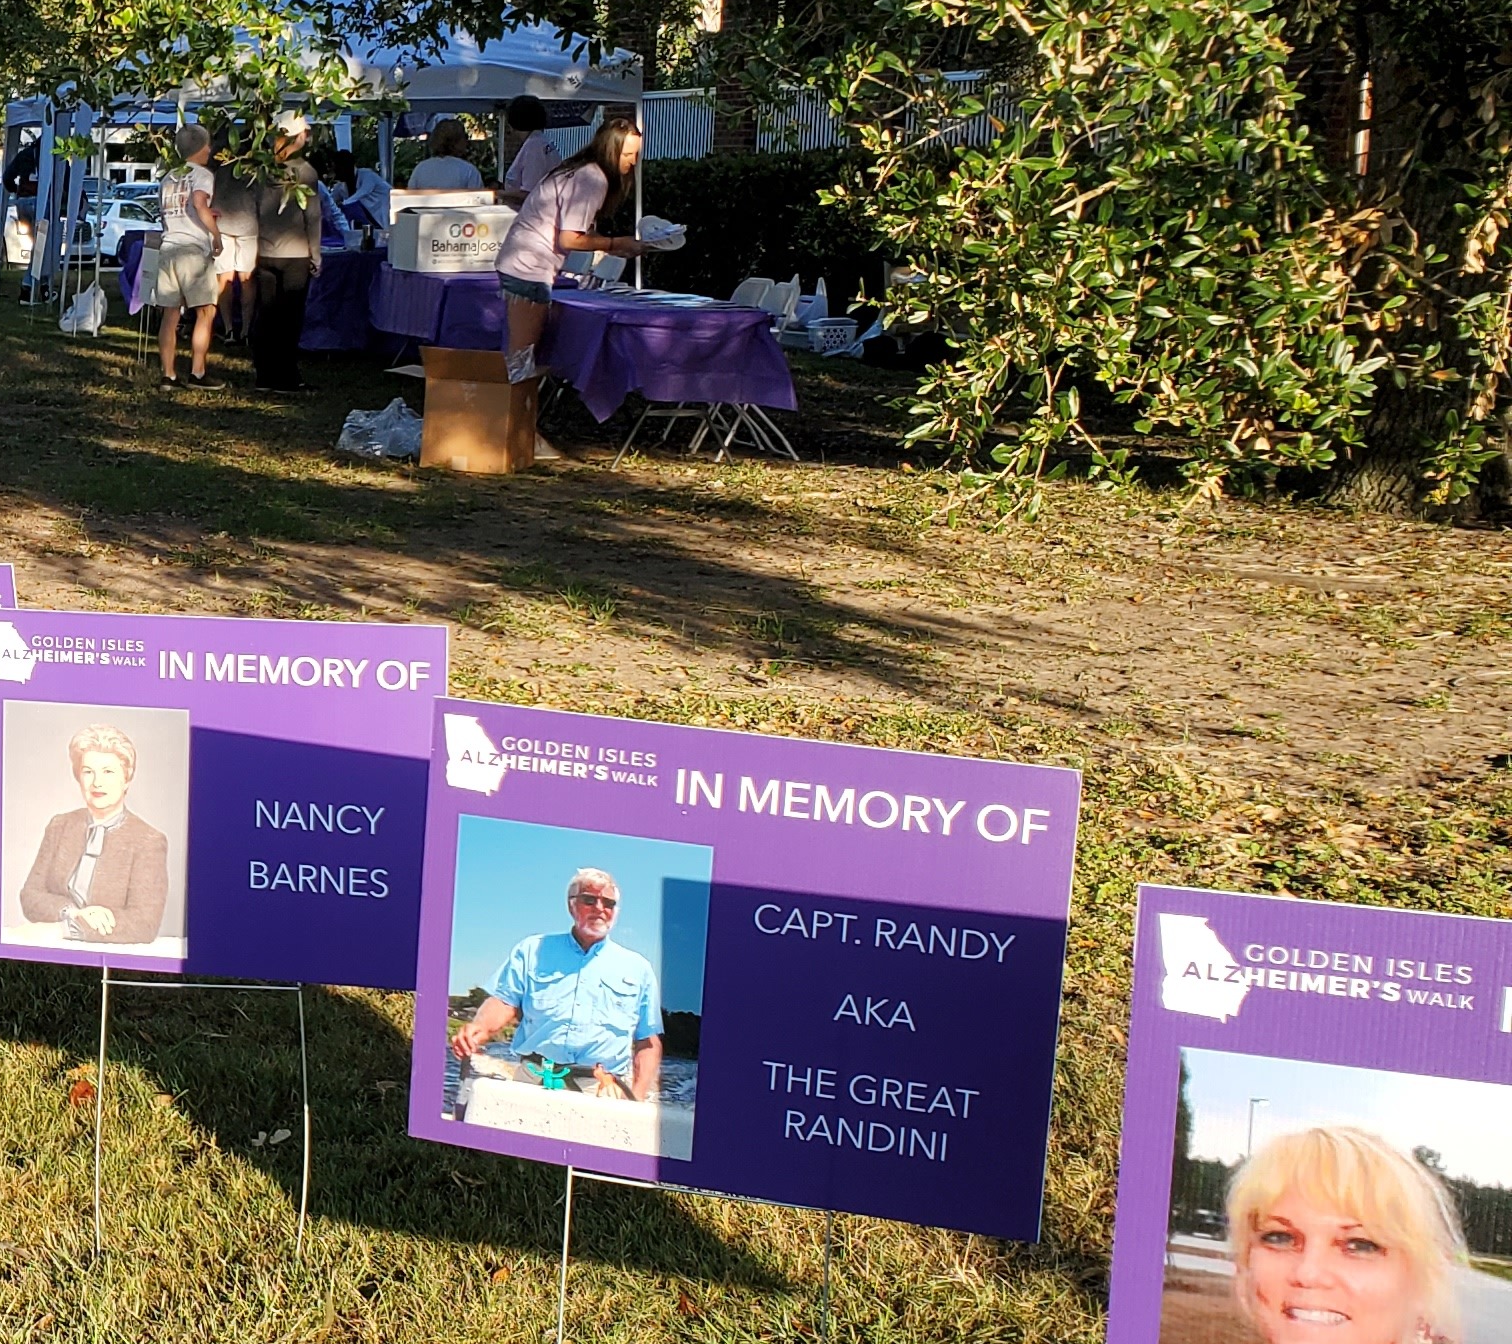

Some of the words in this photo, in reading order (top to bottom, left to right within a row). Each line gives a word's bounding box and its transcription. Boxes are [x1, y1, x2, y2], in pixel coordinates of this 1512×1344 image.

[2, 648, 110, 665] ALZHEIMER'S
[112, 655, 146, 667] WALK
[31, 634, 96, 650] GOLDEN
[101, 637, 145, 652] ISLES
[158, 650, 194, 681] IN
[205, 652, 369, 689] MEMORY
[376, 659, 431, 692] OF
[460, 749, 609, 782] ALZHEIMER'S
[611, 770, 659, 789] WALK
[501, 735, 590, 761] GOLDEN
[597, 745, 658, 768] ISLES
[255, 799, 386, 835] NANCY
[675, 768, 724, 809] IN
[738, 776, 966, 836] MEMORY
[976, 803, 1051, 846] OF
[249, 861, 389, 899] BARNES
[753, 903, 862, 945] CAPT.
[874, 918, 1016, 964] RANDY
[1245, 944, 1373, 975] GOLDEN
[1387, 958, 1474, 985] ISLES
[1182, 961, 1401, 1003] ALZHEIMER'S
[1407, 988, 1475, 1011] WALK
[833, 993, 917, 1032] AKA
[762, 1060, 838, 1100] THE
[848, 1073, 981, 1119] GREAT
[784, 1110, 950, 1161] RANDINI
